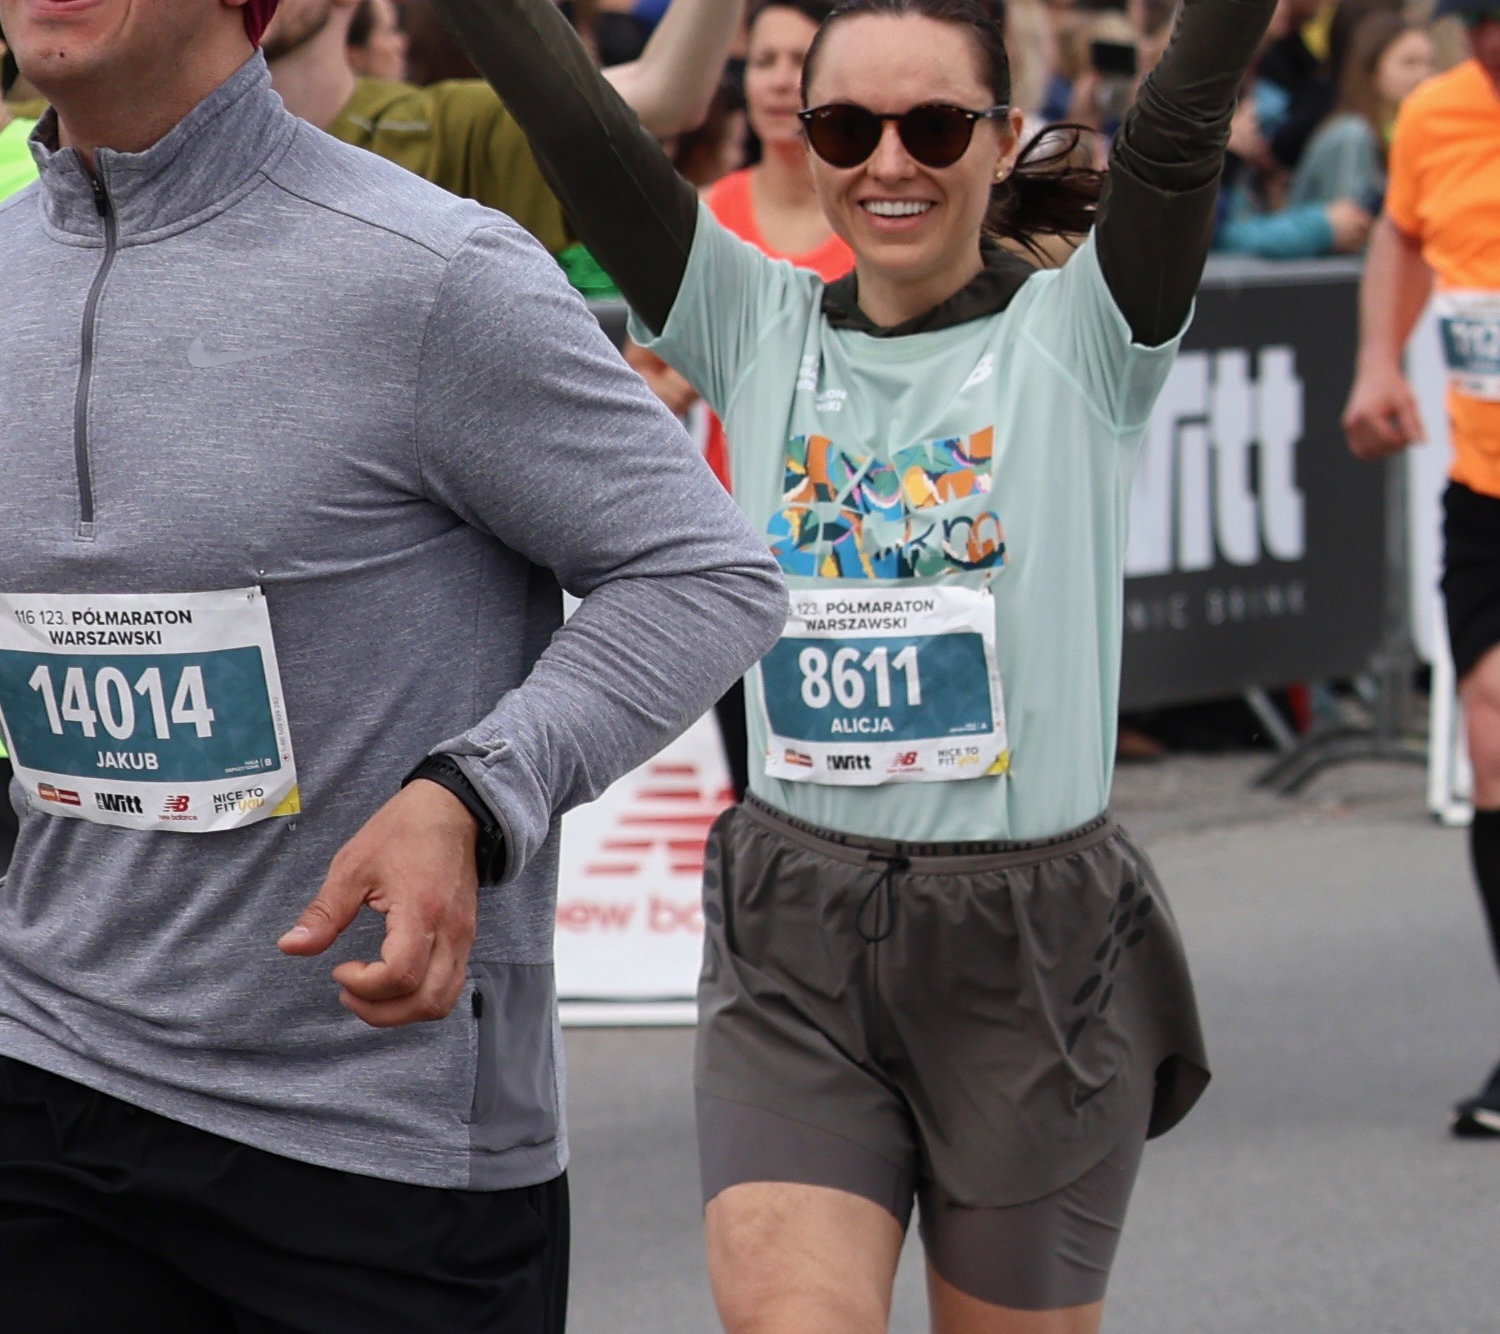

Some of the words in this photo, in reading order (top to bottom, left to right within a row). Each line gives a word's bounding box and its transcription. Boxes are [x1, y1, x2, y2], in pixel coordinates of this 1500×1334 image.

[826, 599, 934, 615] PÓŁMARATON
[72, 607, 193, 625] PÓŁMARATON
[806, 617, 907, 632] WARSZAWSKI
[49, 630, 162, 646] WARSZAWSKI
[799, 645, 922, 710] 8611
[28, 665, 215, 740] 14014
[831, 717, 895, 734] ALICJA
[96, 751, 159, 771] JAKUB
[102, 793, 144, 815] Witt
[213, 790, 243, 804] NICE
[246, 787, 265, 798] TO
[214, 801, 237, 814] FIT
